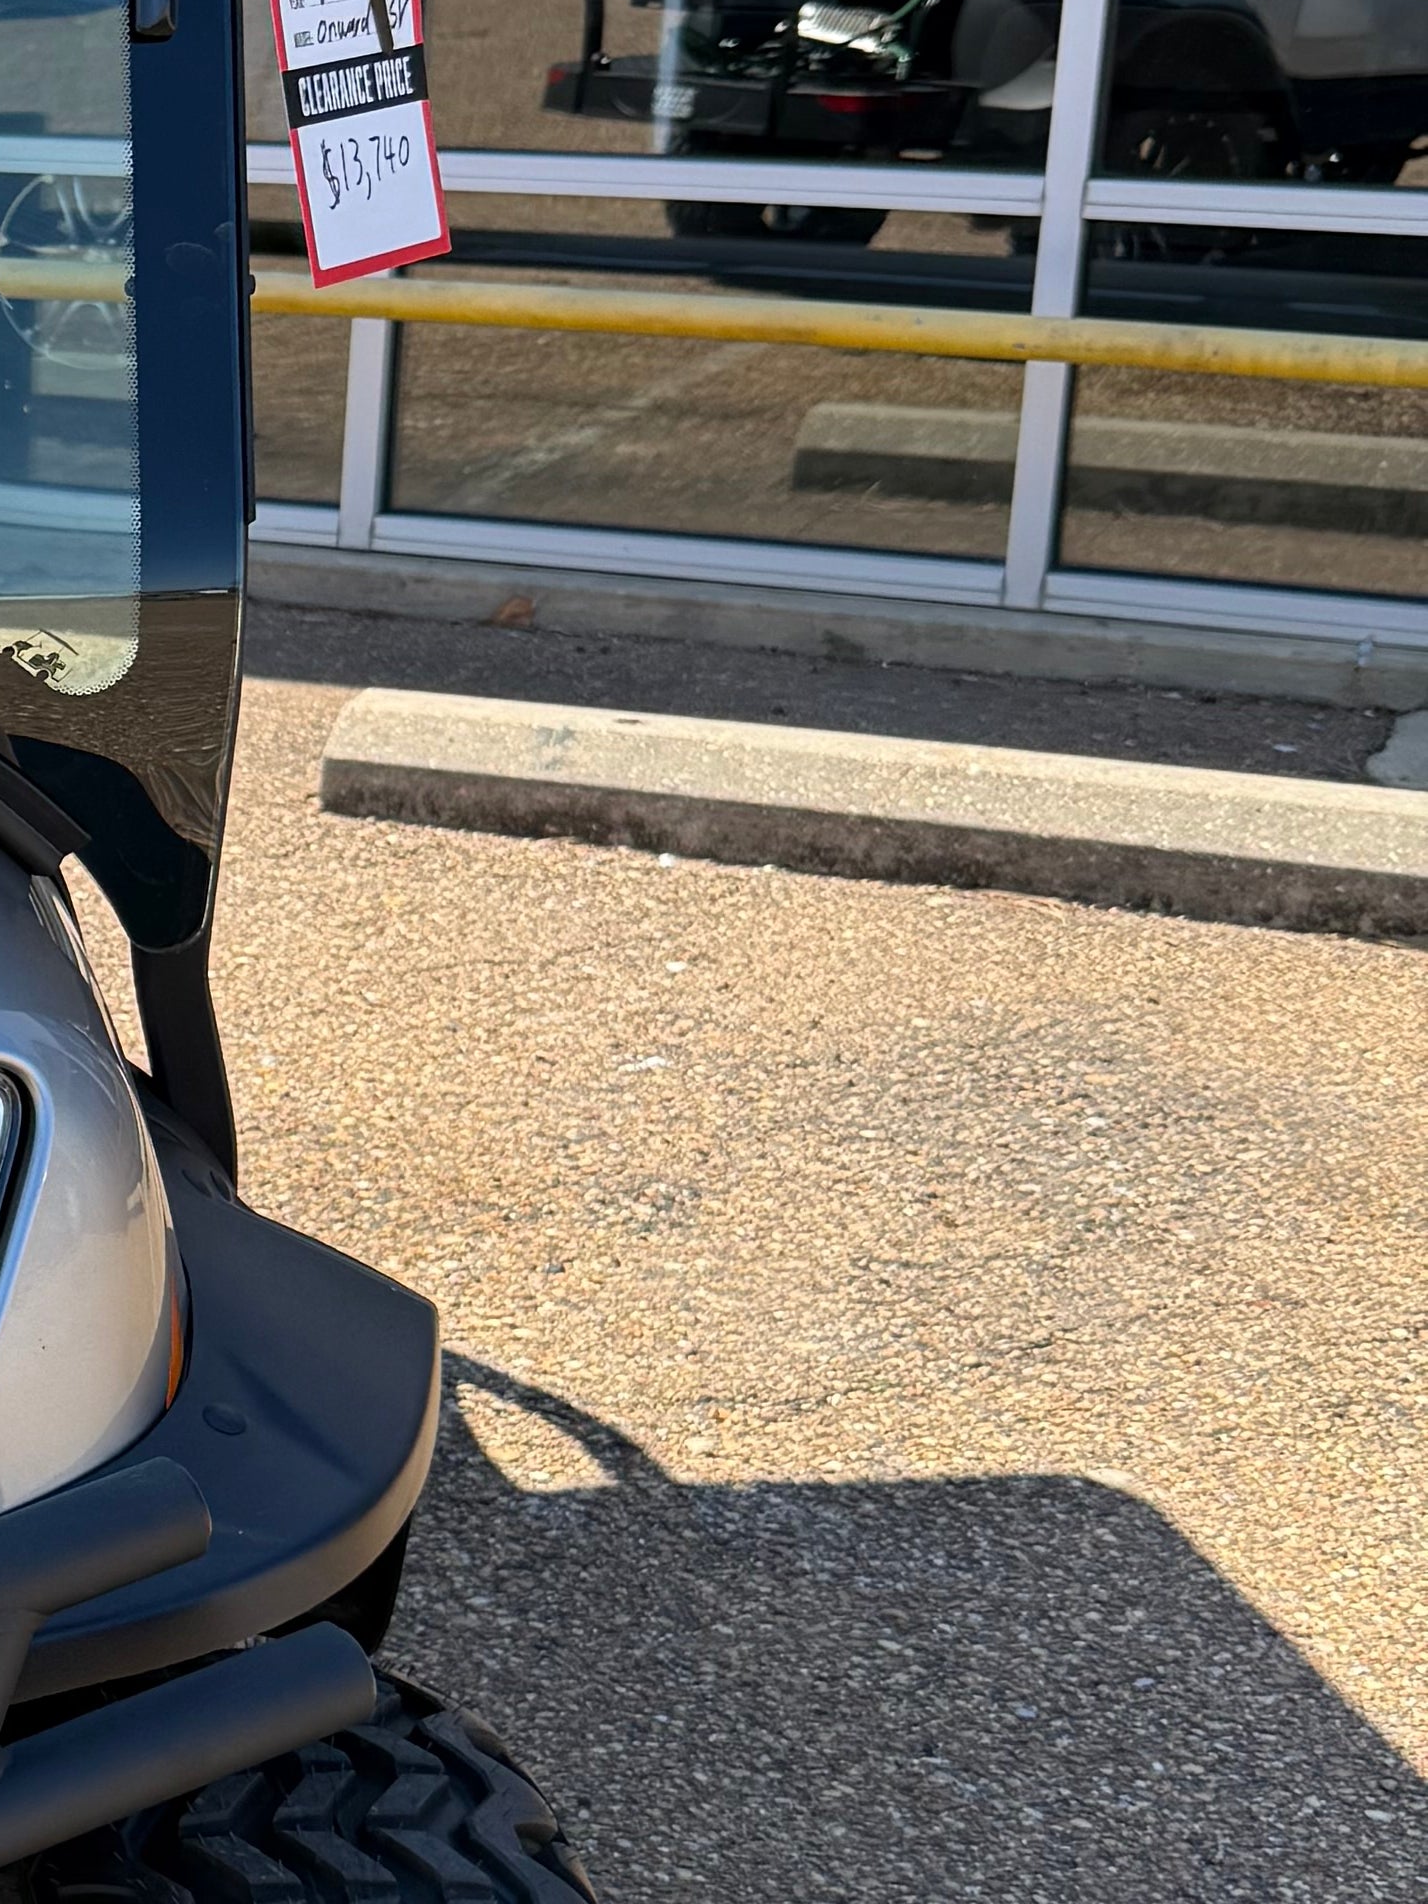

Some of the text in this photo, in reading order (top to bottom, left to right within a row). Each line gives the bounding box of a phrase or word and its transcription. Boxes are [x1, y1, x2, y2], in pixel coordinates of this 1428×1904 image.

[297, 56, 414, 118] CLEARANCE PRICE
[320, 135, 410, 210] $13,740
